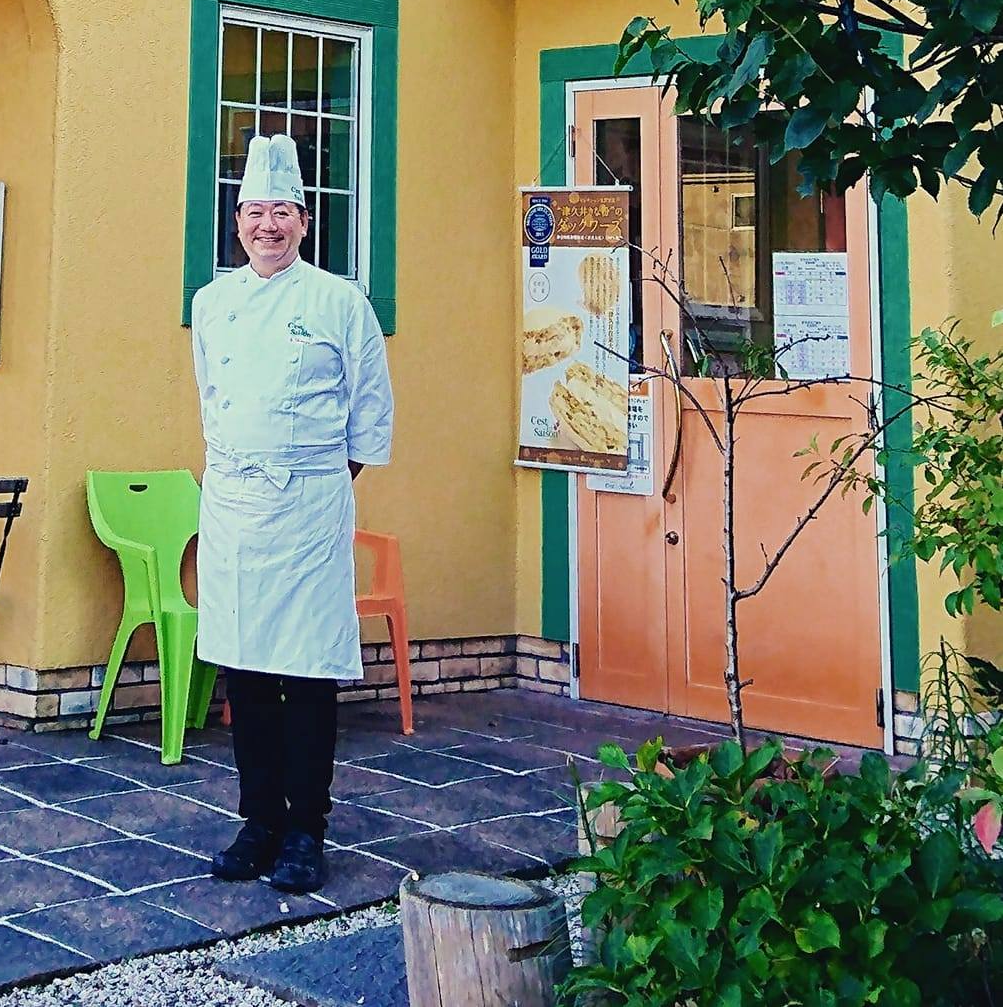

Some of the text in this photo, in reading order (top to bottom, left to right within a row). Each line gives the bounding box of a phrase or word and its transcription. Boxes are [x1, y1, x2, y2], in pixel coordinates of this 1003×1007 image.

[557, 217, 625, 233] ダックワーズ
[530, 246, 548, 254] GOLD
